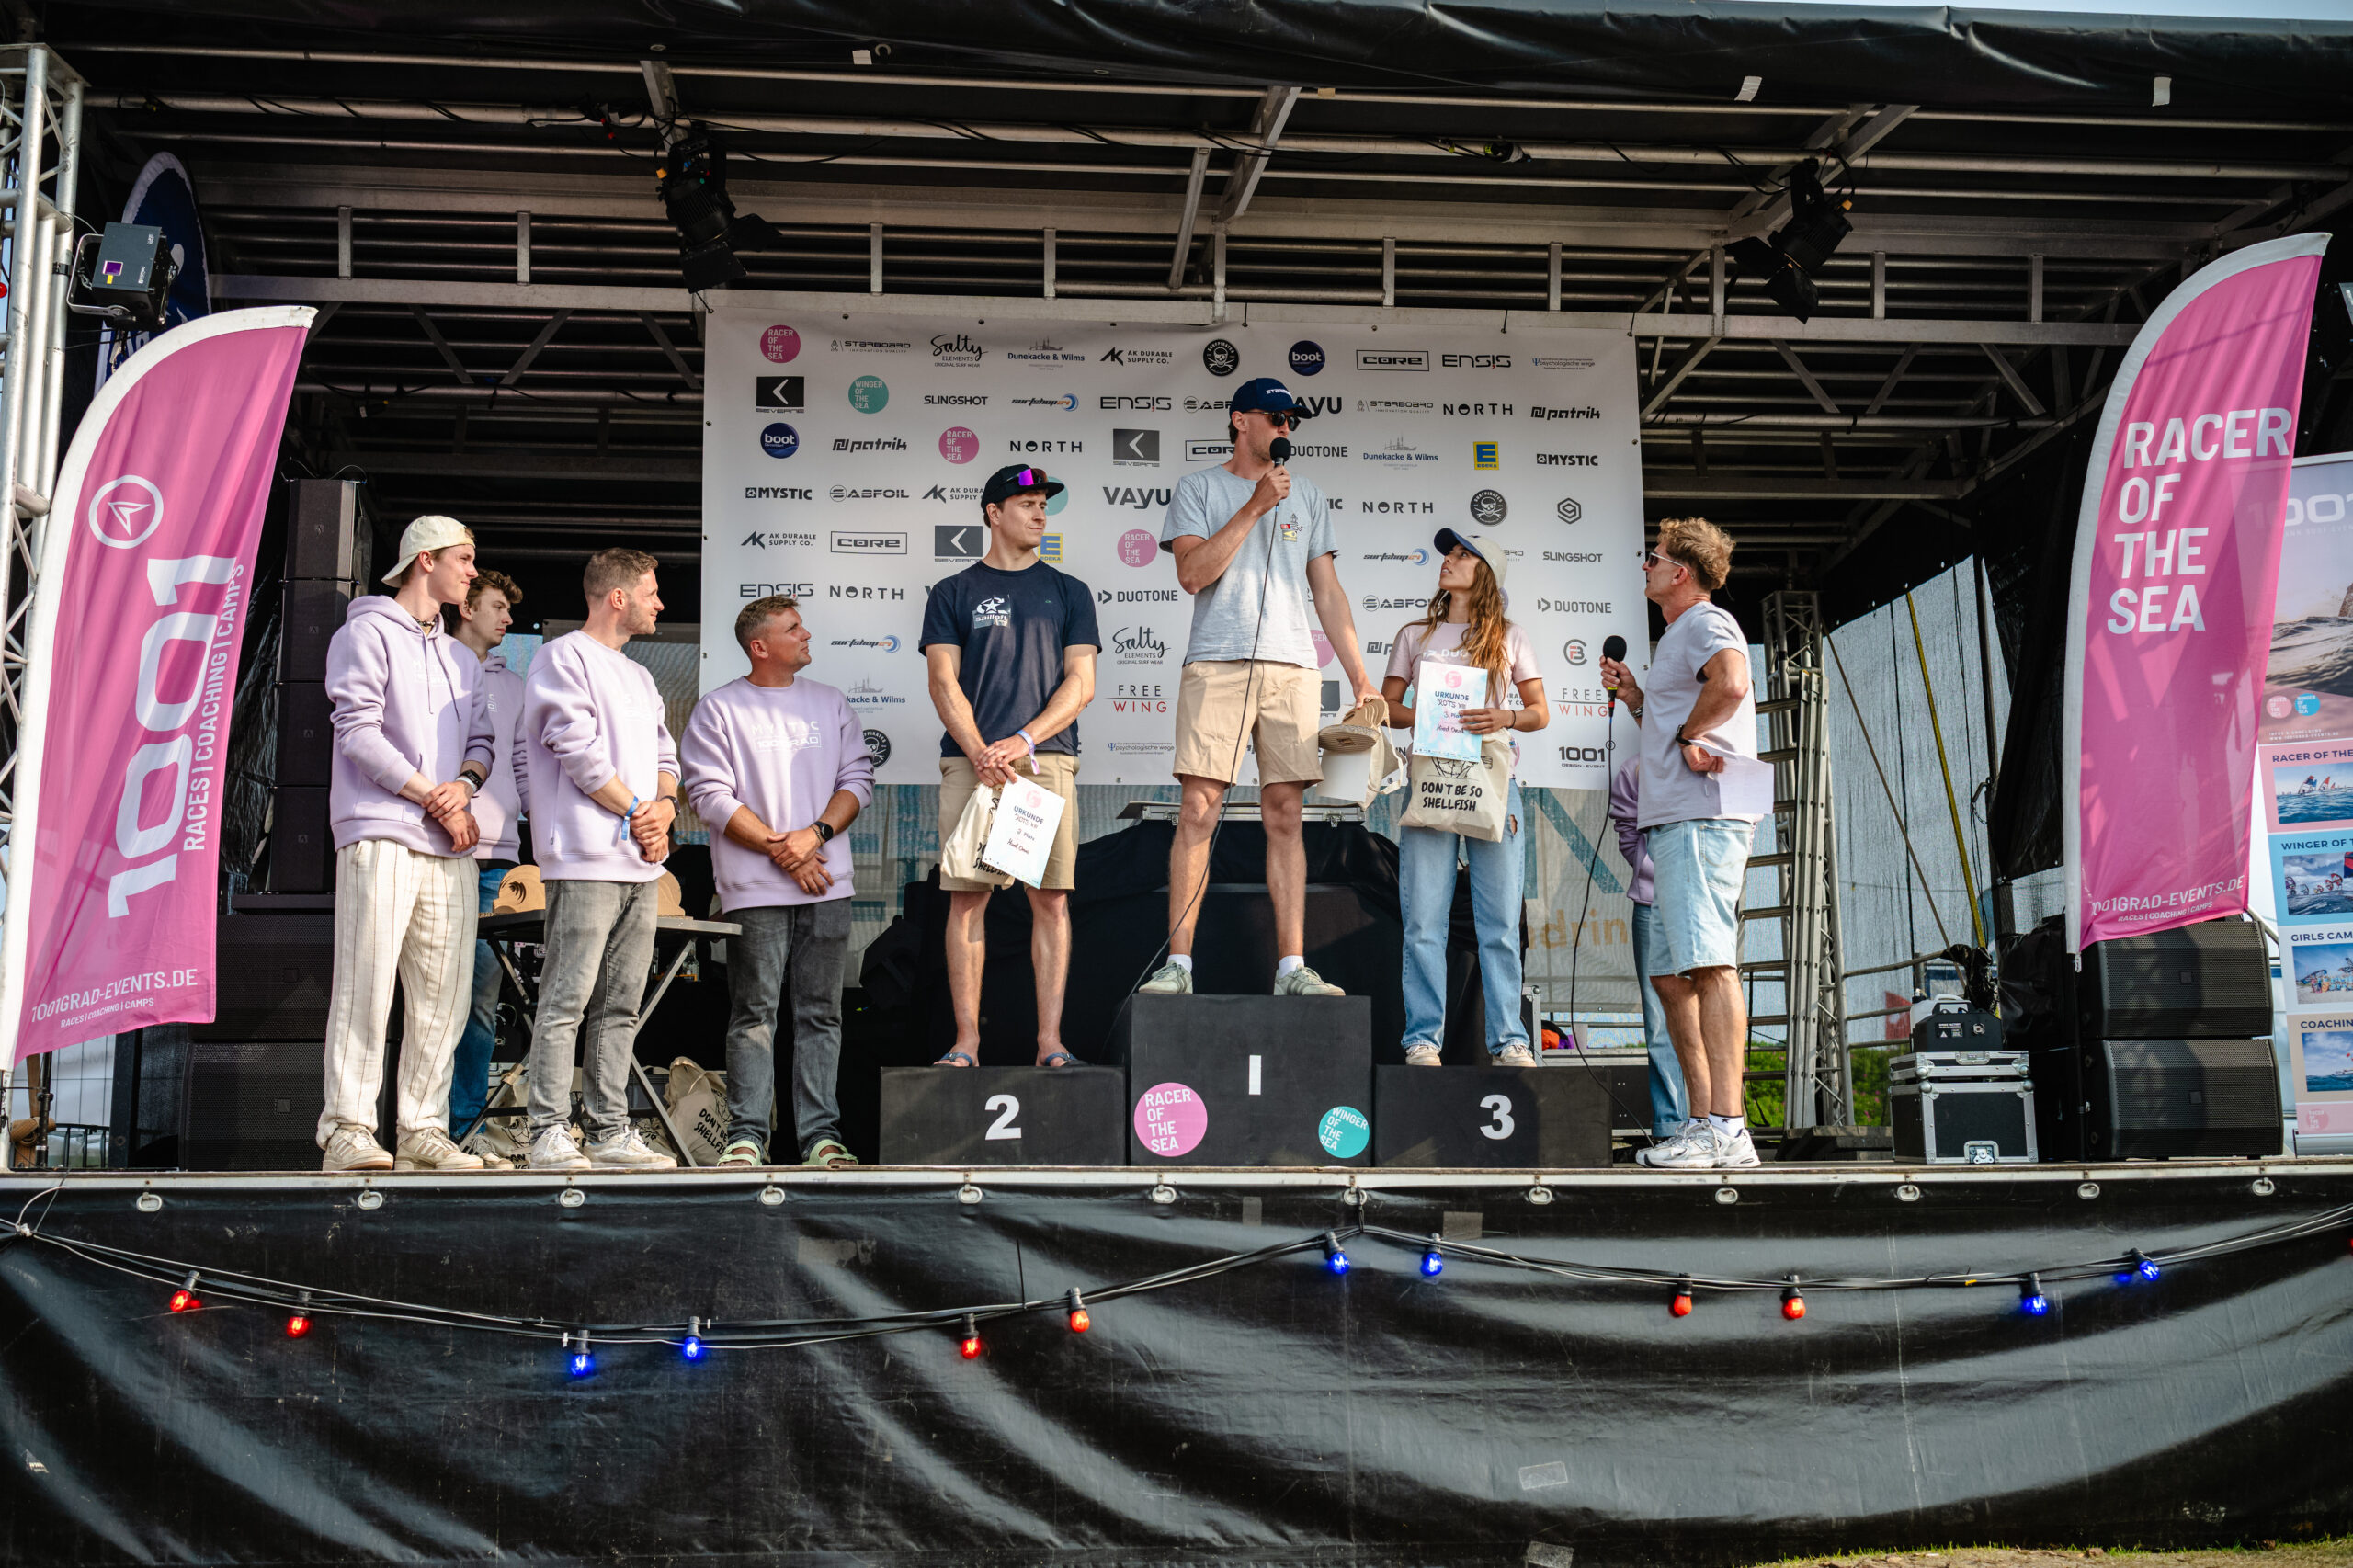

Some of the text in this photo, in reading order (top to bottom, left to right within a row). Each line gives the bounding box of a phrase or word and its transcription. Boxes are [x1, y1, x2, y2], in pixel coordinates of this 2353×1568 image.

[930, 334, 989, 361] Salty
[1007, 352, 1051, 360] Dunekacke
[1291, 351, 1322, 361] boot
[1362, 356, 1423, 365] CORE
[1441, 354, 1511, 369] ENSIS
[855, 381, 883, 389] WINGER
[924, 395, 988, 406] SLINGSHOT
[1100, 396, 1172, 413] ENSIS
[1443, 403, 1513, 415] NORTH
[765, 433, 795, 445] boot
[2123, 407, 2292, 468] RACER
[1010, 440, 1083, 453] NORTH
[1192, 446, 1234, 455] COR
[1290, 446, 1348, 458] DUOTONE
[1362, 452, 1404, 460] Dunekacke
[1548, 455, 1598, 467] MYSTIC
[758, 487, 813, 500] MYSTIC
[1102, 486, 1171, 509] VAYU
[2119, 473, 2181, 524] OF
[1362, 502, 1434, 514] NORTH
[837, 538, 901, 549] CORE
[1542, 551, 1603, 562] SLINGSHOT
[2114, 527, 2209, 579] THE
[740, 583, 813, 598] ENSIS
[829, 585, 904, 600] NORTH
[1117, 590, 1178, 602] DUOTONE
[1554, 600, 1612, 613] DUOTONE
[2107, 585, 2206, 634] SEA
[975, 614, 1007, 622] sailloft
[1112, 626, 1171, 658] Salty
[1118, 685, 1161, 696] FREE
[1435, 690, 1470, 701] URKUNDE
[1563, 688, 1602, 700] FREE
[184, 564, 244, 851] RACES COACHING CAMPS
[1113, 700, 1167, 712] WING
[1559, 704, 1608, 717] WING
[108, 554, 237, 919] 1001
[1558, 746, 1605, 762] 1001
[2272, 749, 2353, 762] RACER OF THE
[1454, 784, 1466, 795] BE
[1470, 785, 1483, 798] SO
[1422, 797, 1477, 812] SHELLFISH
[1014, 805, 1044, 824] URKUNDE
[2281, 840, 2328, 850] WINGER
[2118, 902, 2213, 923] RACES COACHING CAMPS
[2291, 933, 2324, 942] GIRLS
[31, 969, 199, 1023] 1001GRAD-EVENTS.DE
[61, 998, 154, 1028] RACES COACHING CAMPS
[1144, 1088, 1191, 1108] RACER
[984, 1094, 1023, 1140] 2
[1146, 1107, 1165, 1122] OF
[1333, 1107, 1369, 1131] WINGER
[1479, 1094, 1515, 1140] 3
[1148, 1120, 1176, 1137] THE
[1326, 1116, 1340, 1128] OF
[694, 1121, 727, 1155] SHELLFIS
[719, 1128, 728, 1142] BE
[1324, 1126, 1343, 1141] THE
[1151, 1136, 1179, 1153] SEA
[1319, 1135, 1338, 1151] SEA
